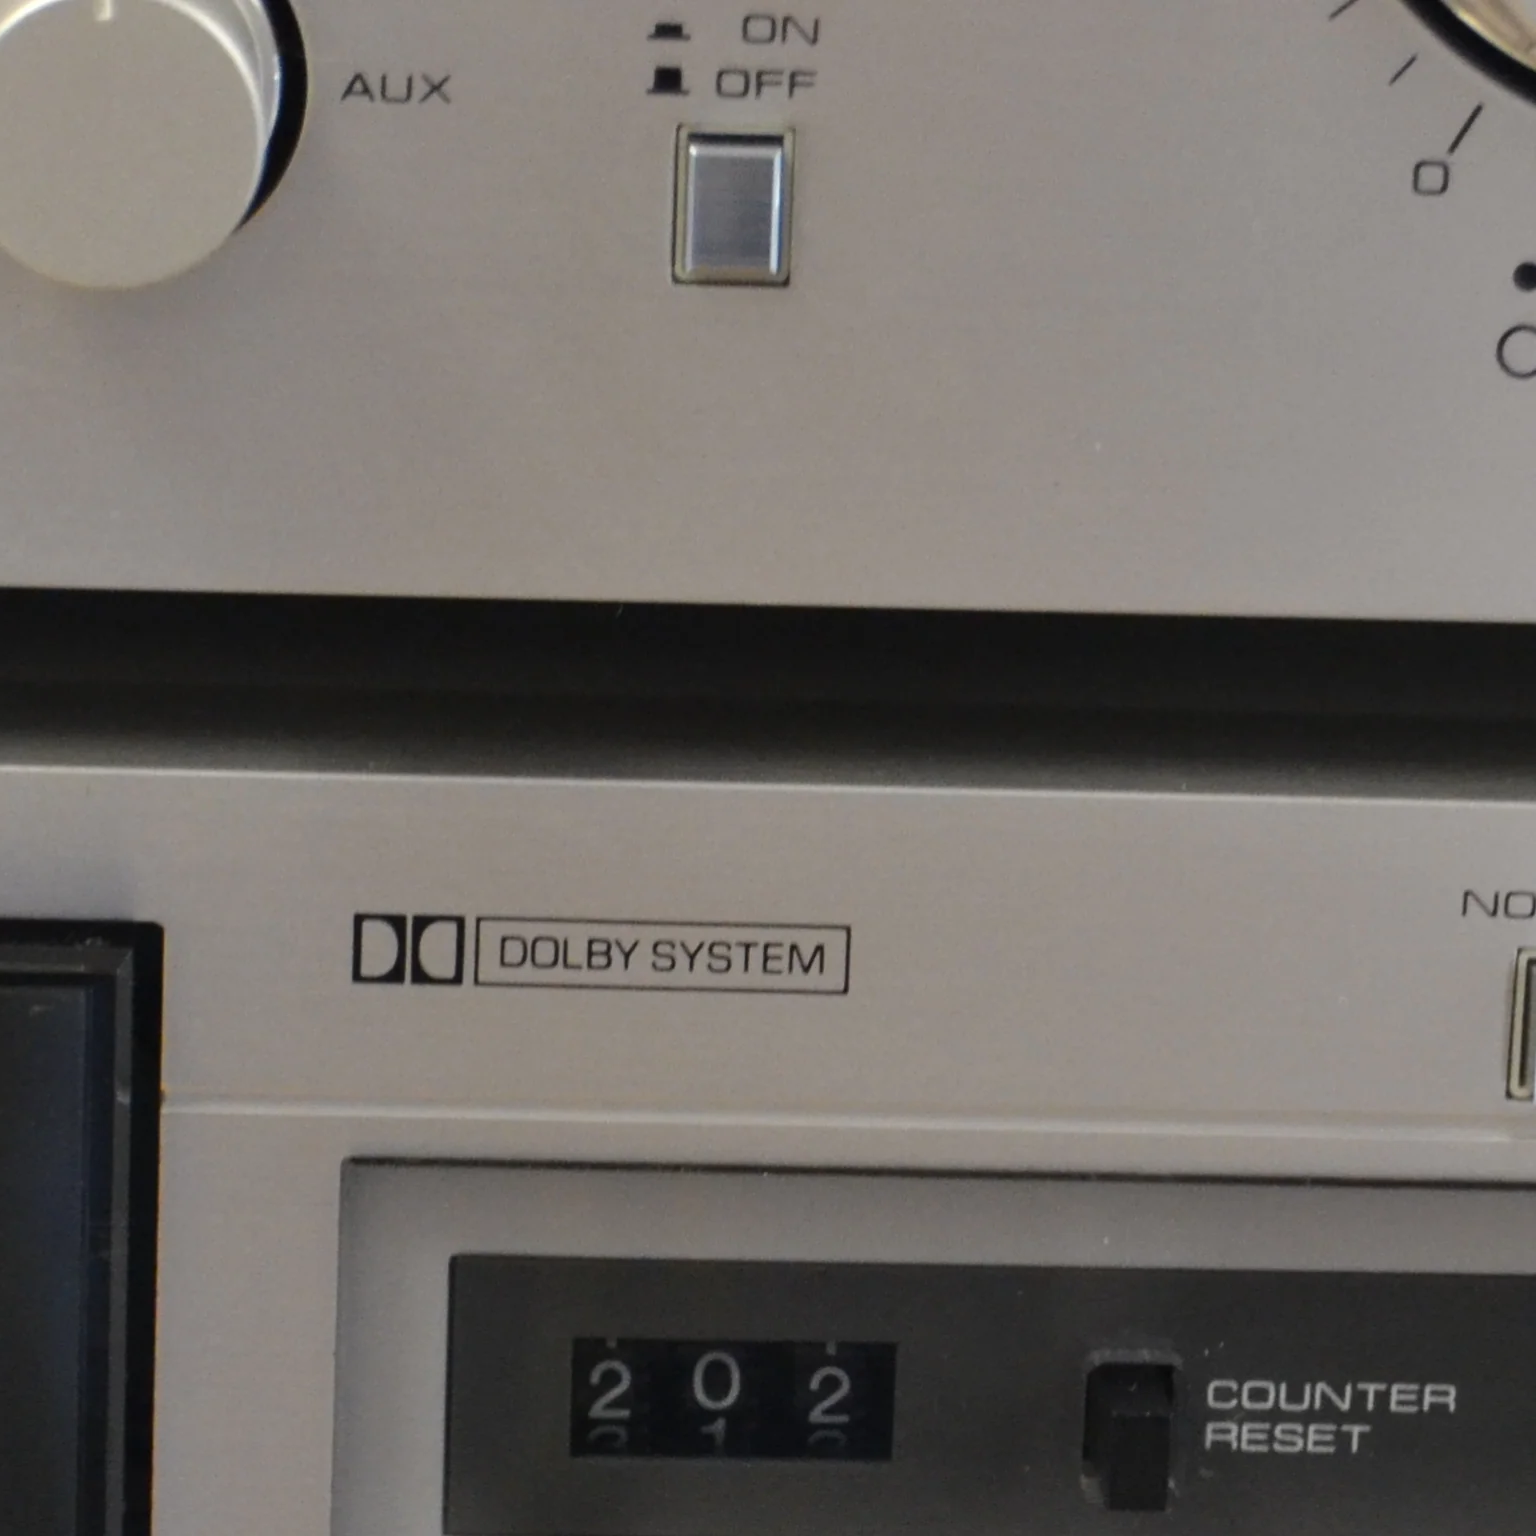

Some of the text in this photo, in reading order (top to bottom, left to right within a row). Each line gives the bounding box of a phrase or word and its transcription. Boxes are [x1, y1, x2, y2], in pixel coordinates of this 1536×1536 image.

[741, 13, 820, 46] ON
[341, 72, 450, 104] AUX
[715, 68, 814, 99] OFF
[1412, 159, 1450, 196] 0
[499, 935, 825, 975] DOLBY SYSTEM
[1206, 1379, 1457, 1413] COUNTER
[1205, 1421, 1371, 1453] RESET
